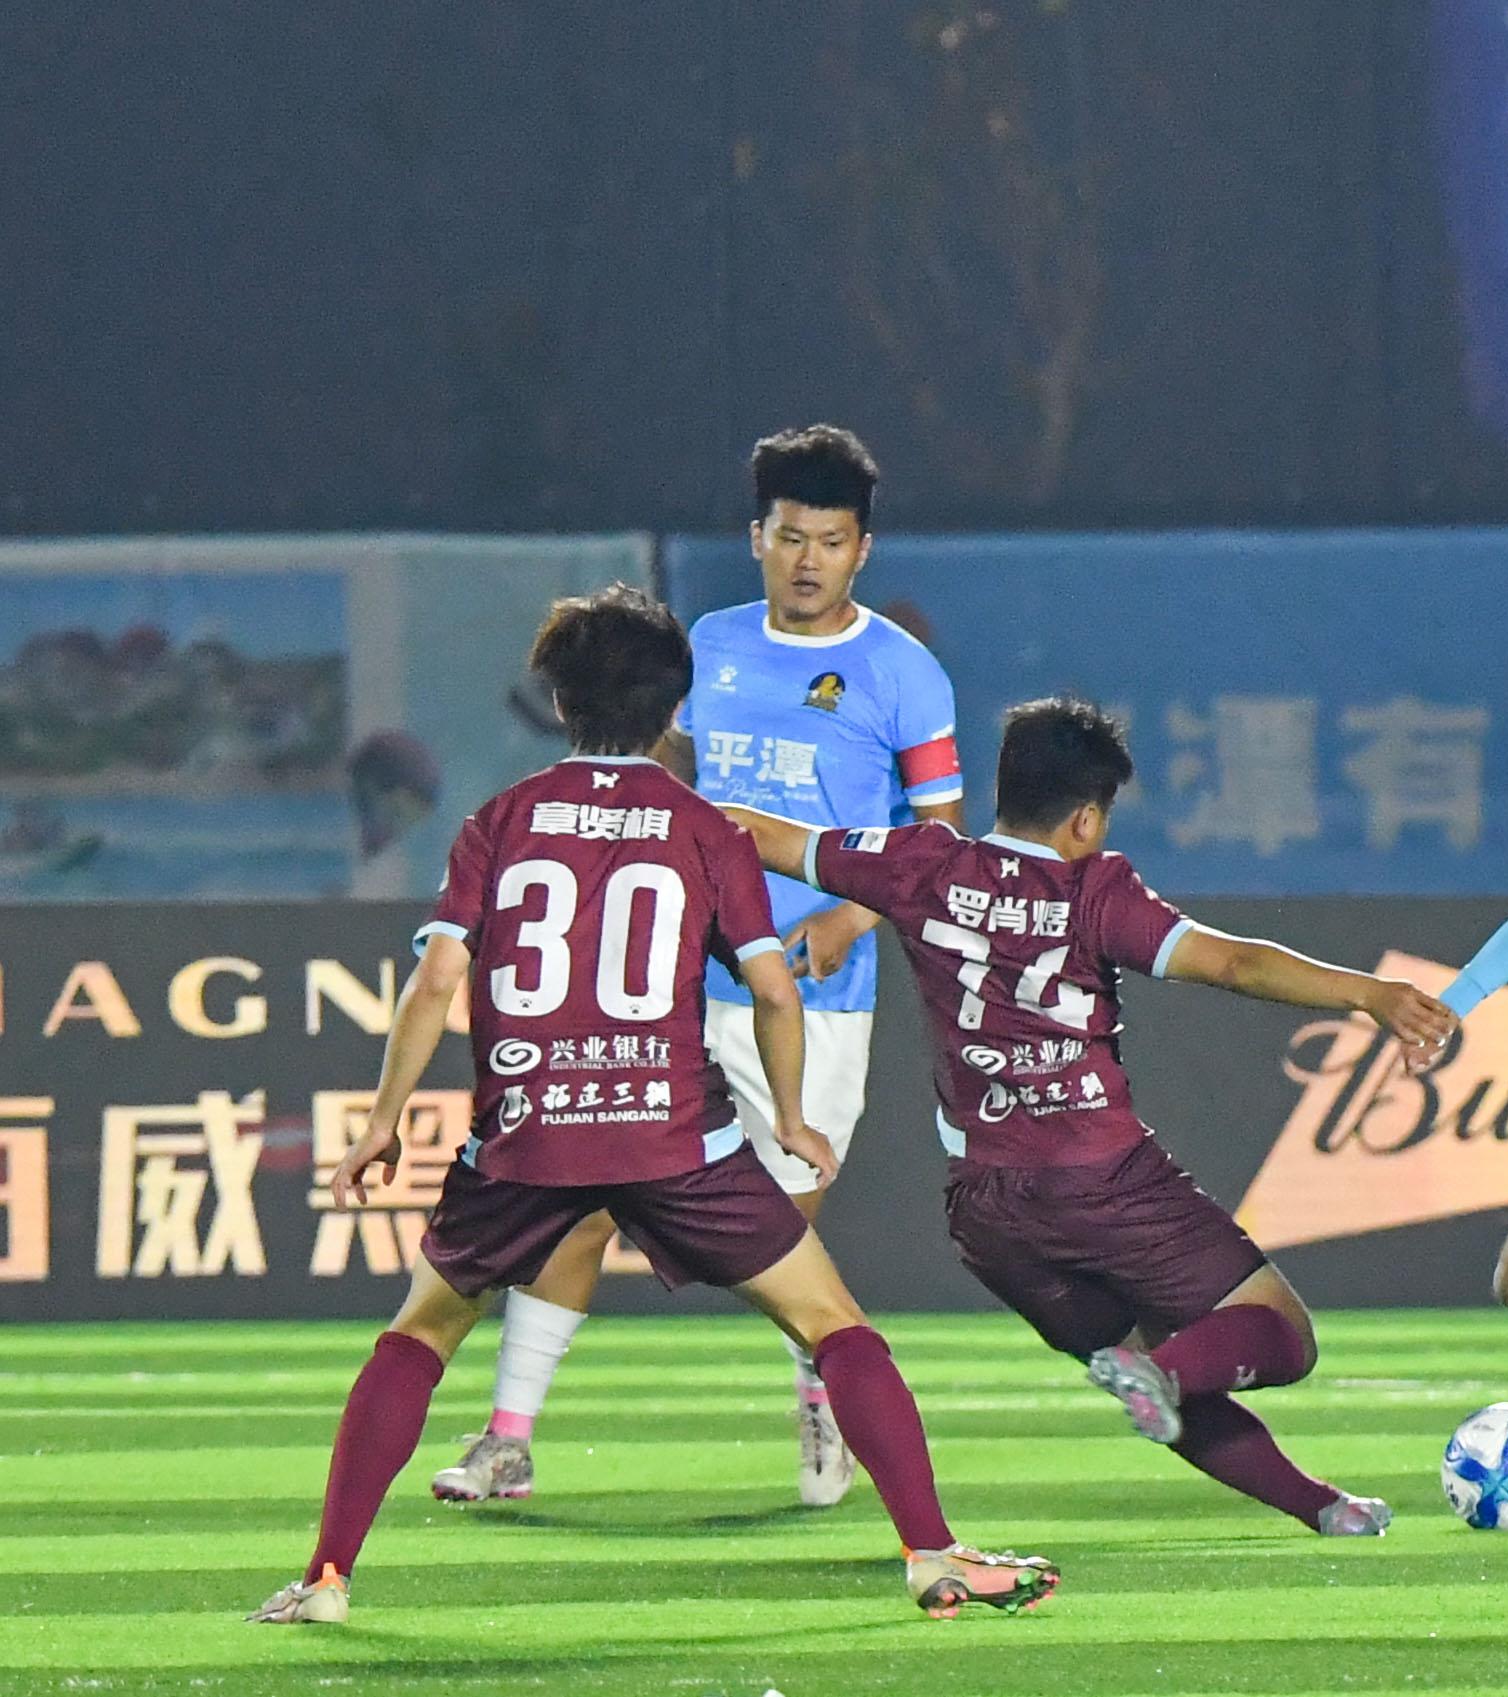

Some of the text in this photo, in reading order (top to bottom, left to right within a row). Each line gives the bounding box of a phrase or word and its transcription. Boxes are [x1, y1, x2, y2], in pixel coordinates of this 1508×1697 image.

[704, 730, 819, 788] 平潭
[490, 858, 686, 1022] 30
[0, 956, 470, 1038] AGN
[549, 1034, 671, 1061] 兴业银行
[1011, 1037, 1088, 1068] 兴业银
[541, 1080, 671, 1110] 福建三钢
[541, 1110, 670, 1125] FUJIAN SANGANG
[0, 1088, 655, 1283] 威黑
